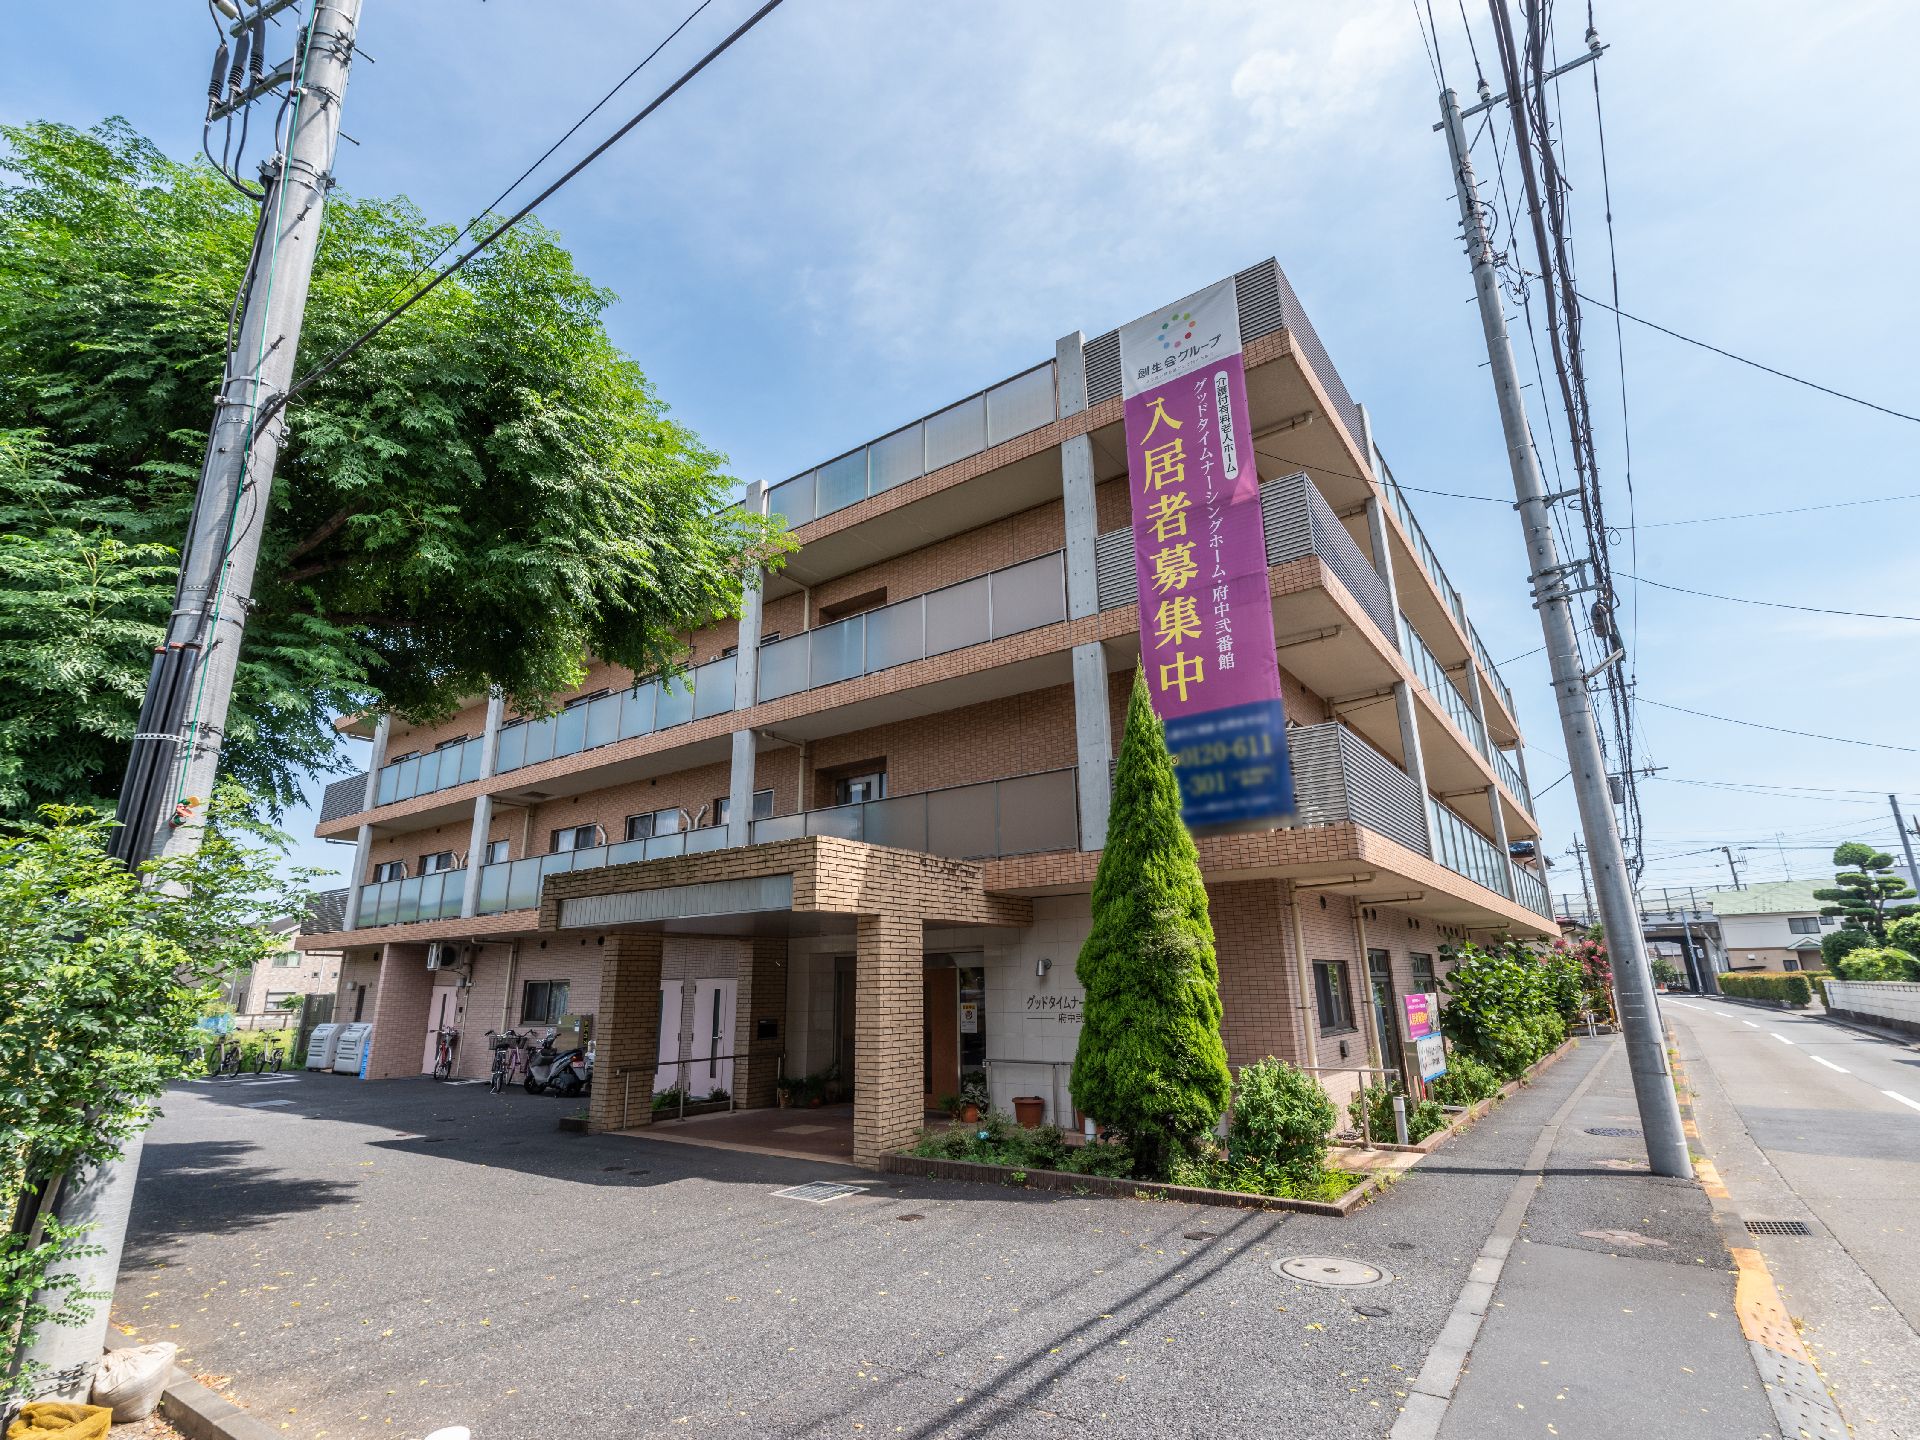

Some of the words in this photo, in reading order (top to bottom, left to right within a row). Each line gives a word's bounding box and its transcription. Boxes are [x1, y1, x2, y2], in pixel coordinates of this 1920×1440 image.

[1137, 334, 1222, 379] 創生会グループ
[1216, 377, 1237, 473] 介護付有料老人ホーム
[1140, 397, 1204, 702] 入居者募集中
